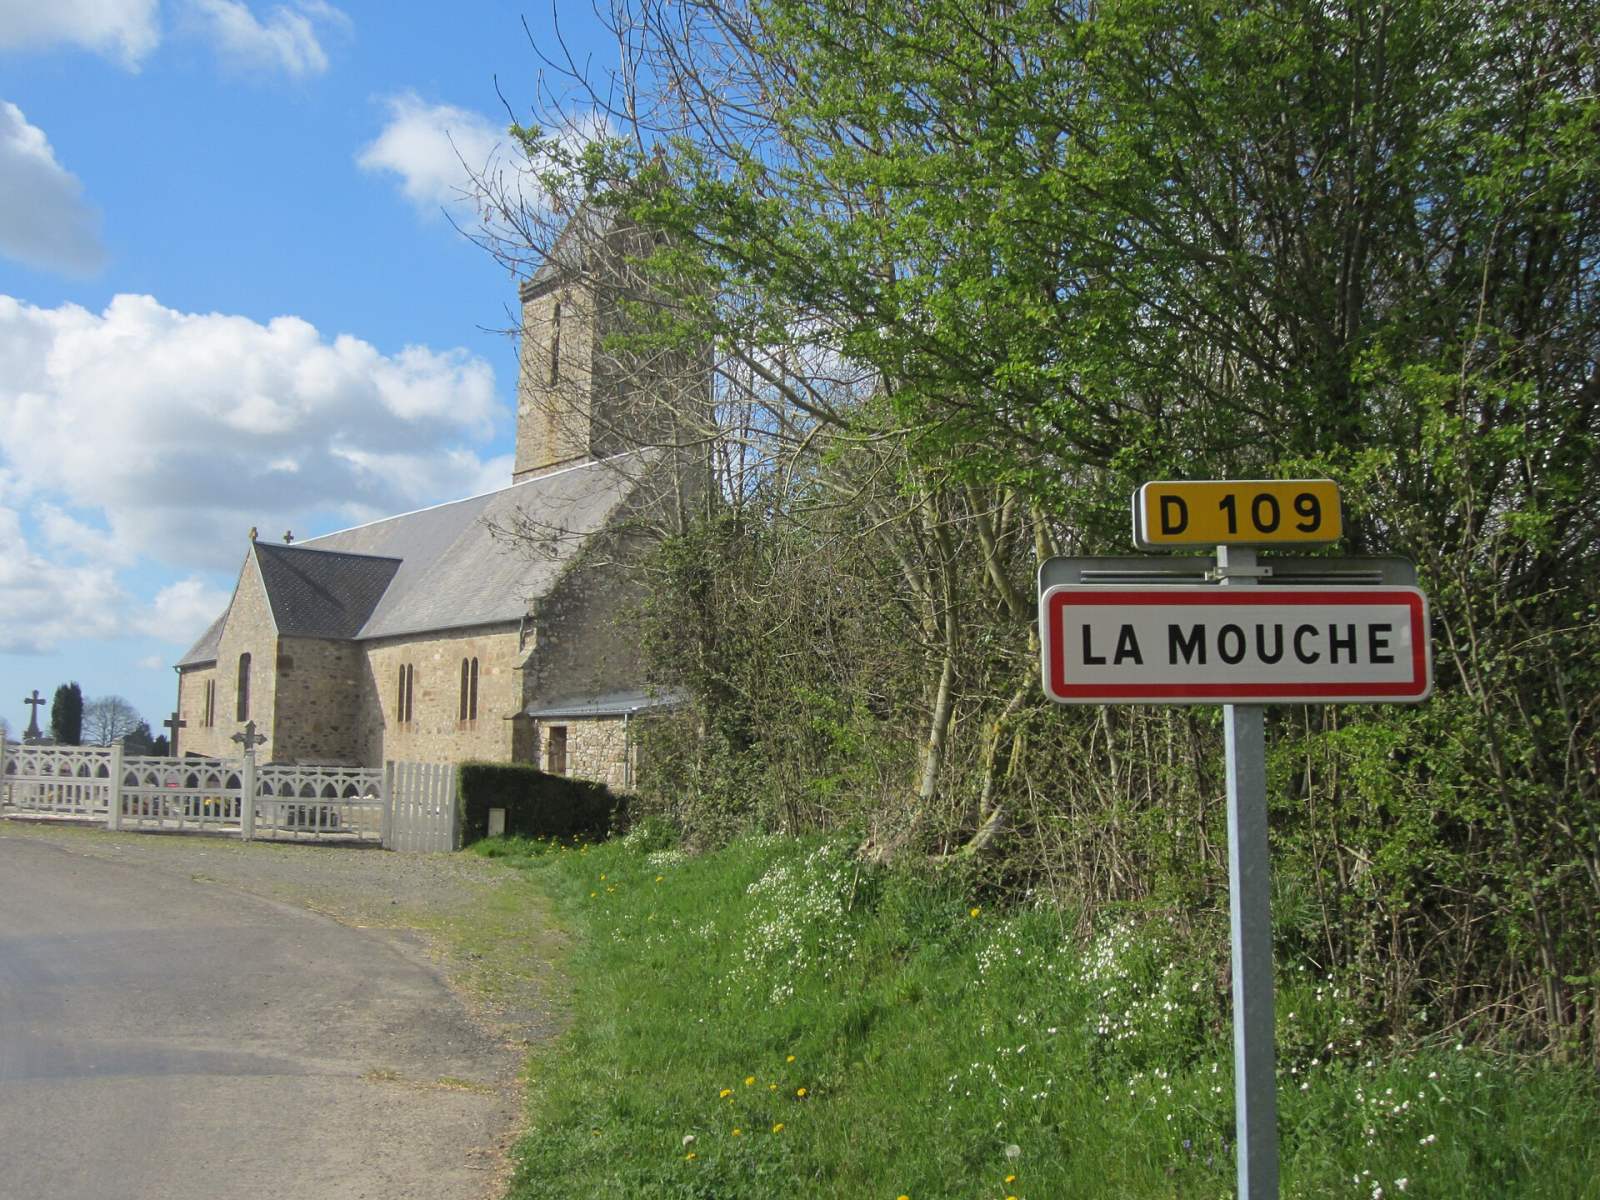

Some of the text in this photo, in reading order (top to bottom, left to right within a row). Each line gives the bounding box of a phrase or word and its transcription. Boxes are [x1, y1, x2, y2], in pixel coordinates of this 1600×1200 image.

[1160, 493, 1322, 535] D 109
[1082, 623, 1394, 665] LA MOUCHE
